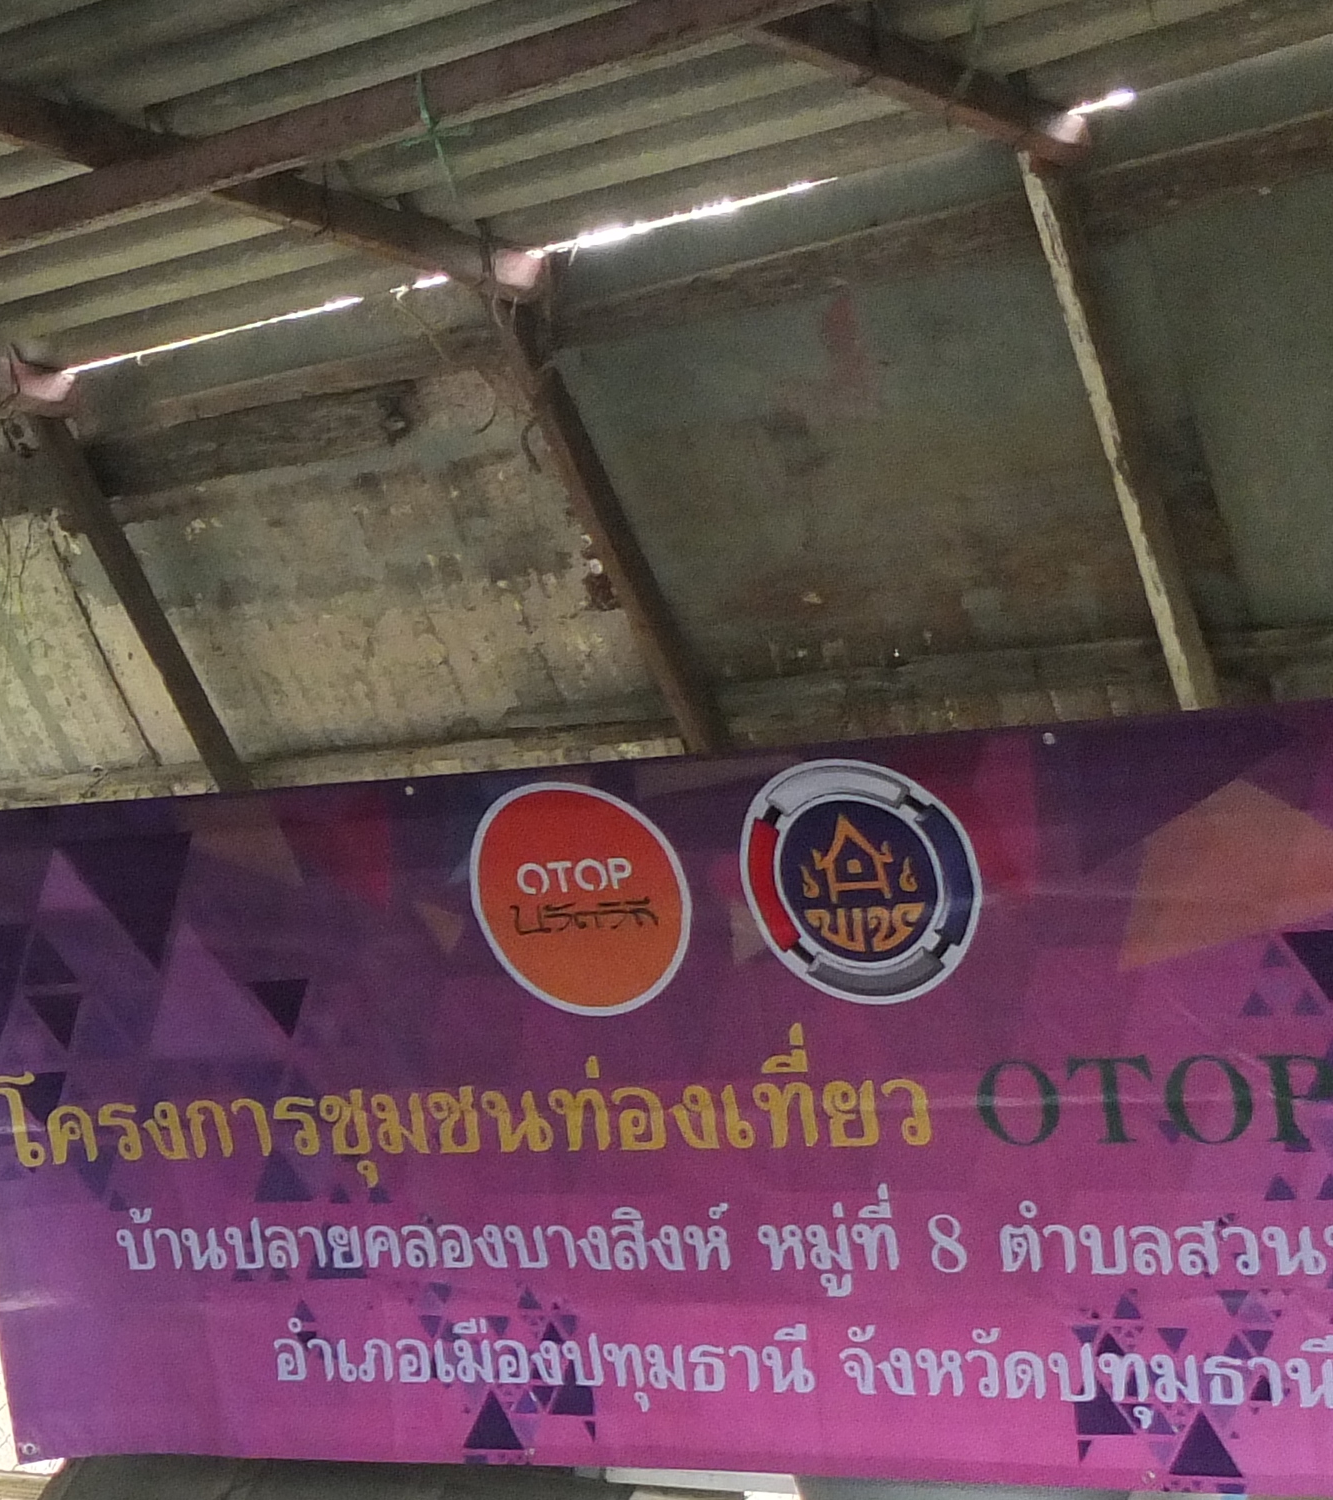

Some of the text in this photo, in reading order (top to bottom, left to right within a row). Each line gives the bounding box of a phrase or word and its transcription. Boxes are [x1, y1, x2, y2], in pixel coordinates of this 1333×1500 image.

[516, 857, 633, 895] OTOP
[976, 1053, 1333, 1147] OTOP
[117, 1184, 1333, 1297] บ้านปลายคลองบางสิงห์ หมู่ที่ 8 ตำบลสวน
[274, 1318, 815, 1412] อำเภอเมืองปทุมธานี
